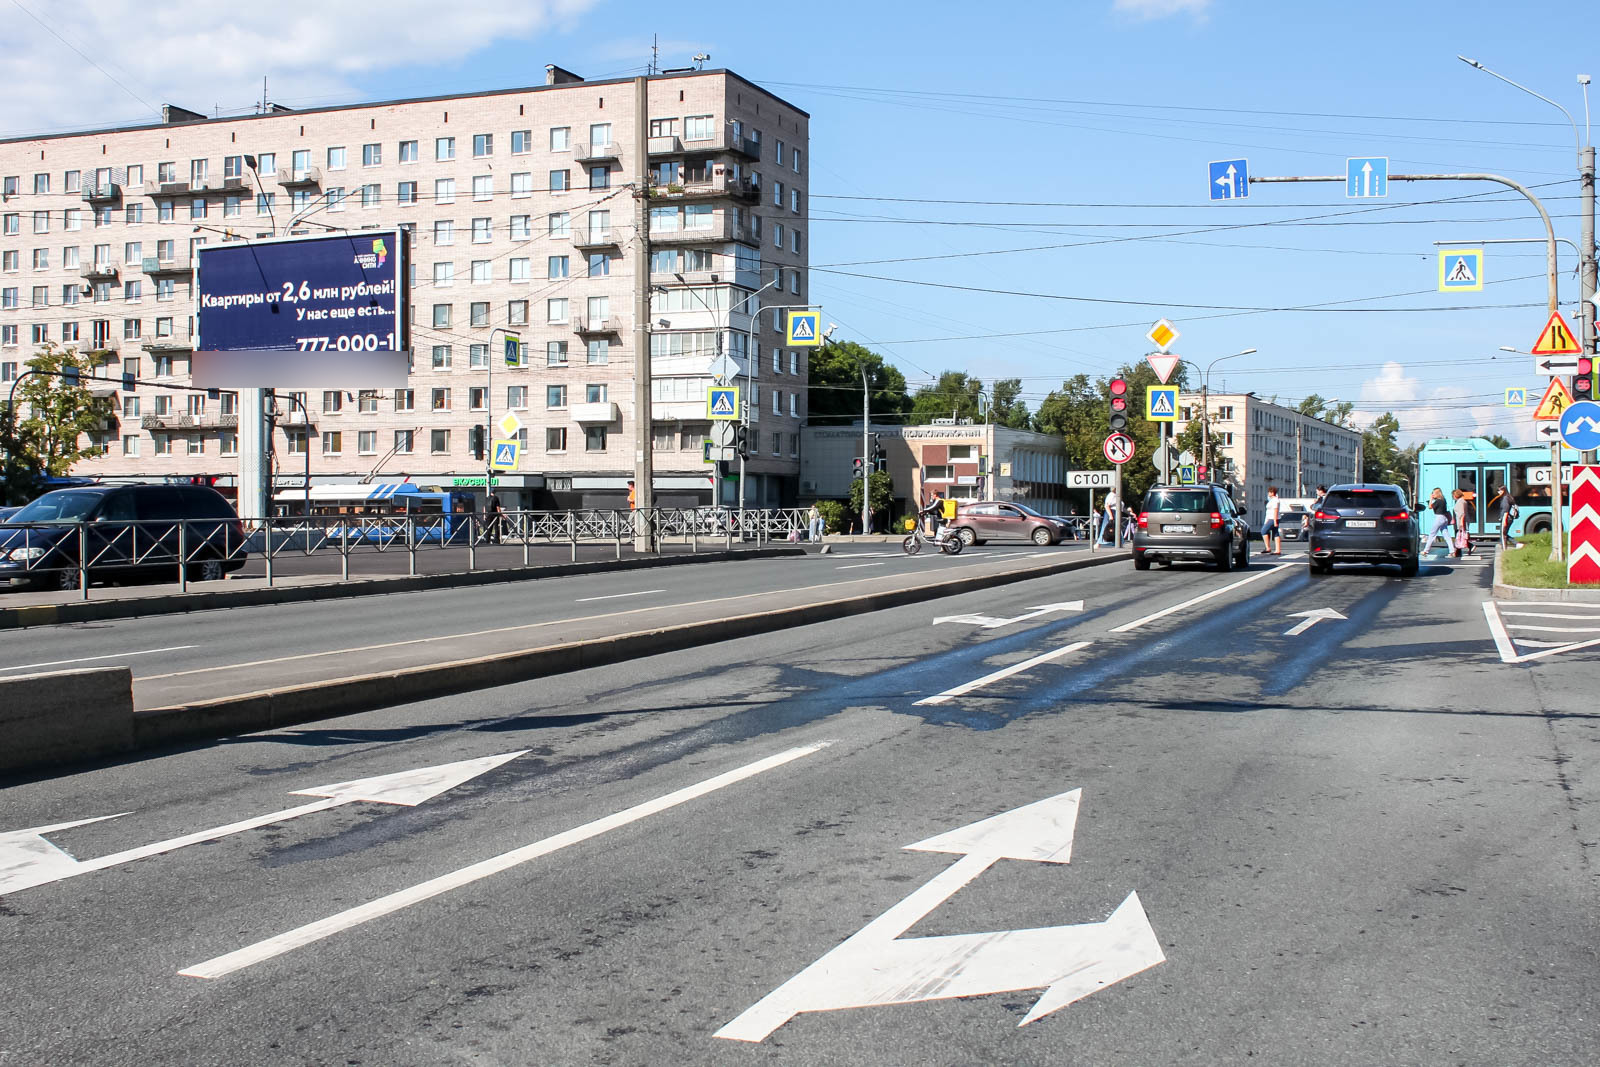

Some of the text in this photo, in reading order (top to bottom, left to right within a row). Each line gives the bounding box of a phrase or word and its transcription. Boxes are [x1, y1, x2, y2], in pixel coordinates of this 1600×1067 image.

[202, 279, 395, 309] Квартиры от 2,6 млн рублей!
[296, 306, 395, 321] У нас еще есть...
[295, 332, 394, 351] 777-000-1
[452, 477, 499, 486] ВКУСВИЛ
[1074, 473, 1109, 485] СТОП
